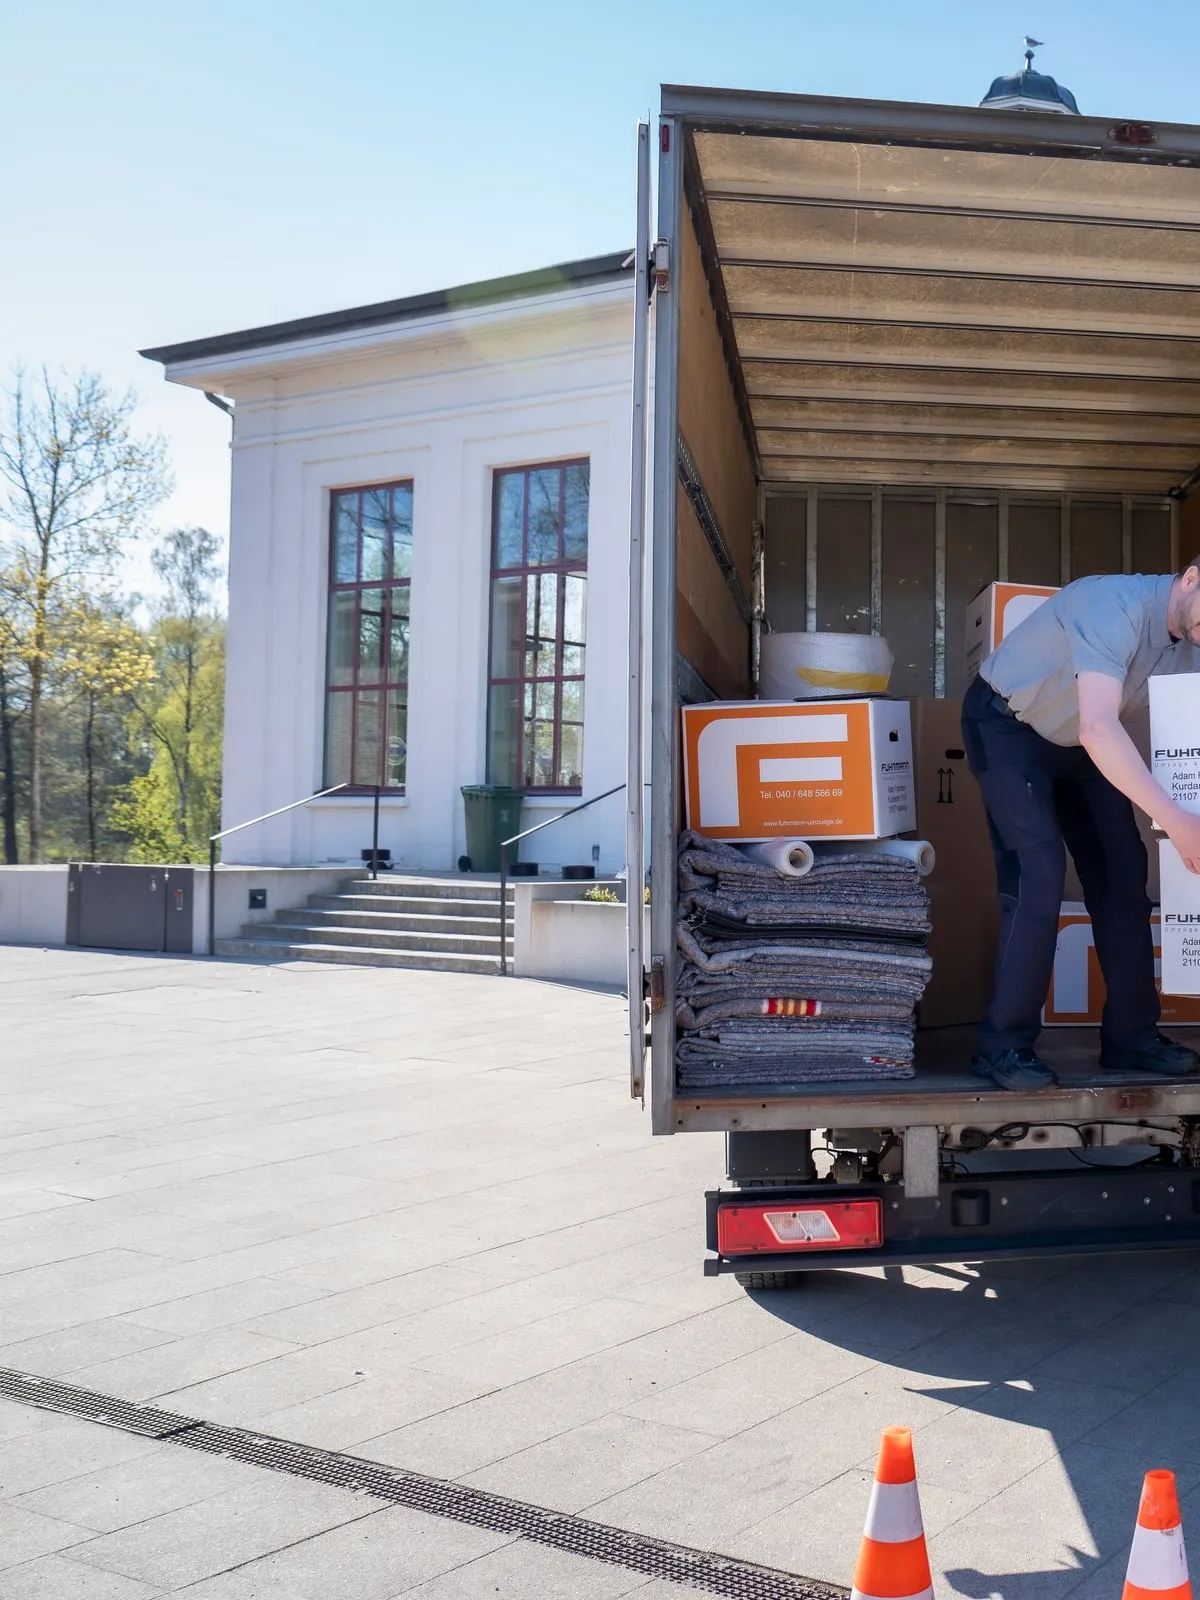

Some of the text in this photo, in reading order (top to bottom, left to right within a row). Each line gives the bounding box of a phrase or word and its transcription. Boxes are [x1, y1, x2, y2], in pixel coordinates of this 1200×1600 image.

[1172, 772, 1195, 780] Adam
[760, 790, 774, 799] Tel.
[775, 790, 791, 798] 040
[797, 789, 813, 798] 648
[832, 788, 843, 797] 69
[1172, 792, 1198, 801] 21107
